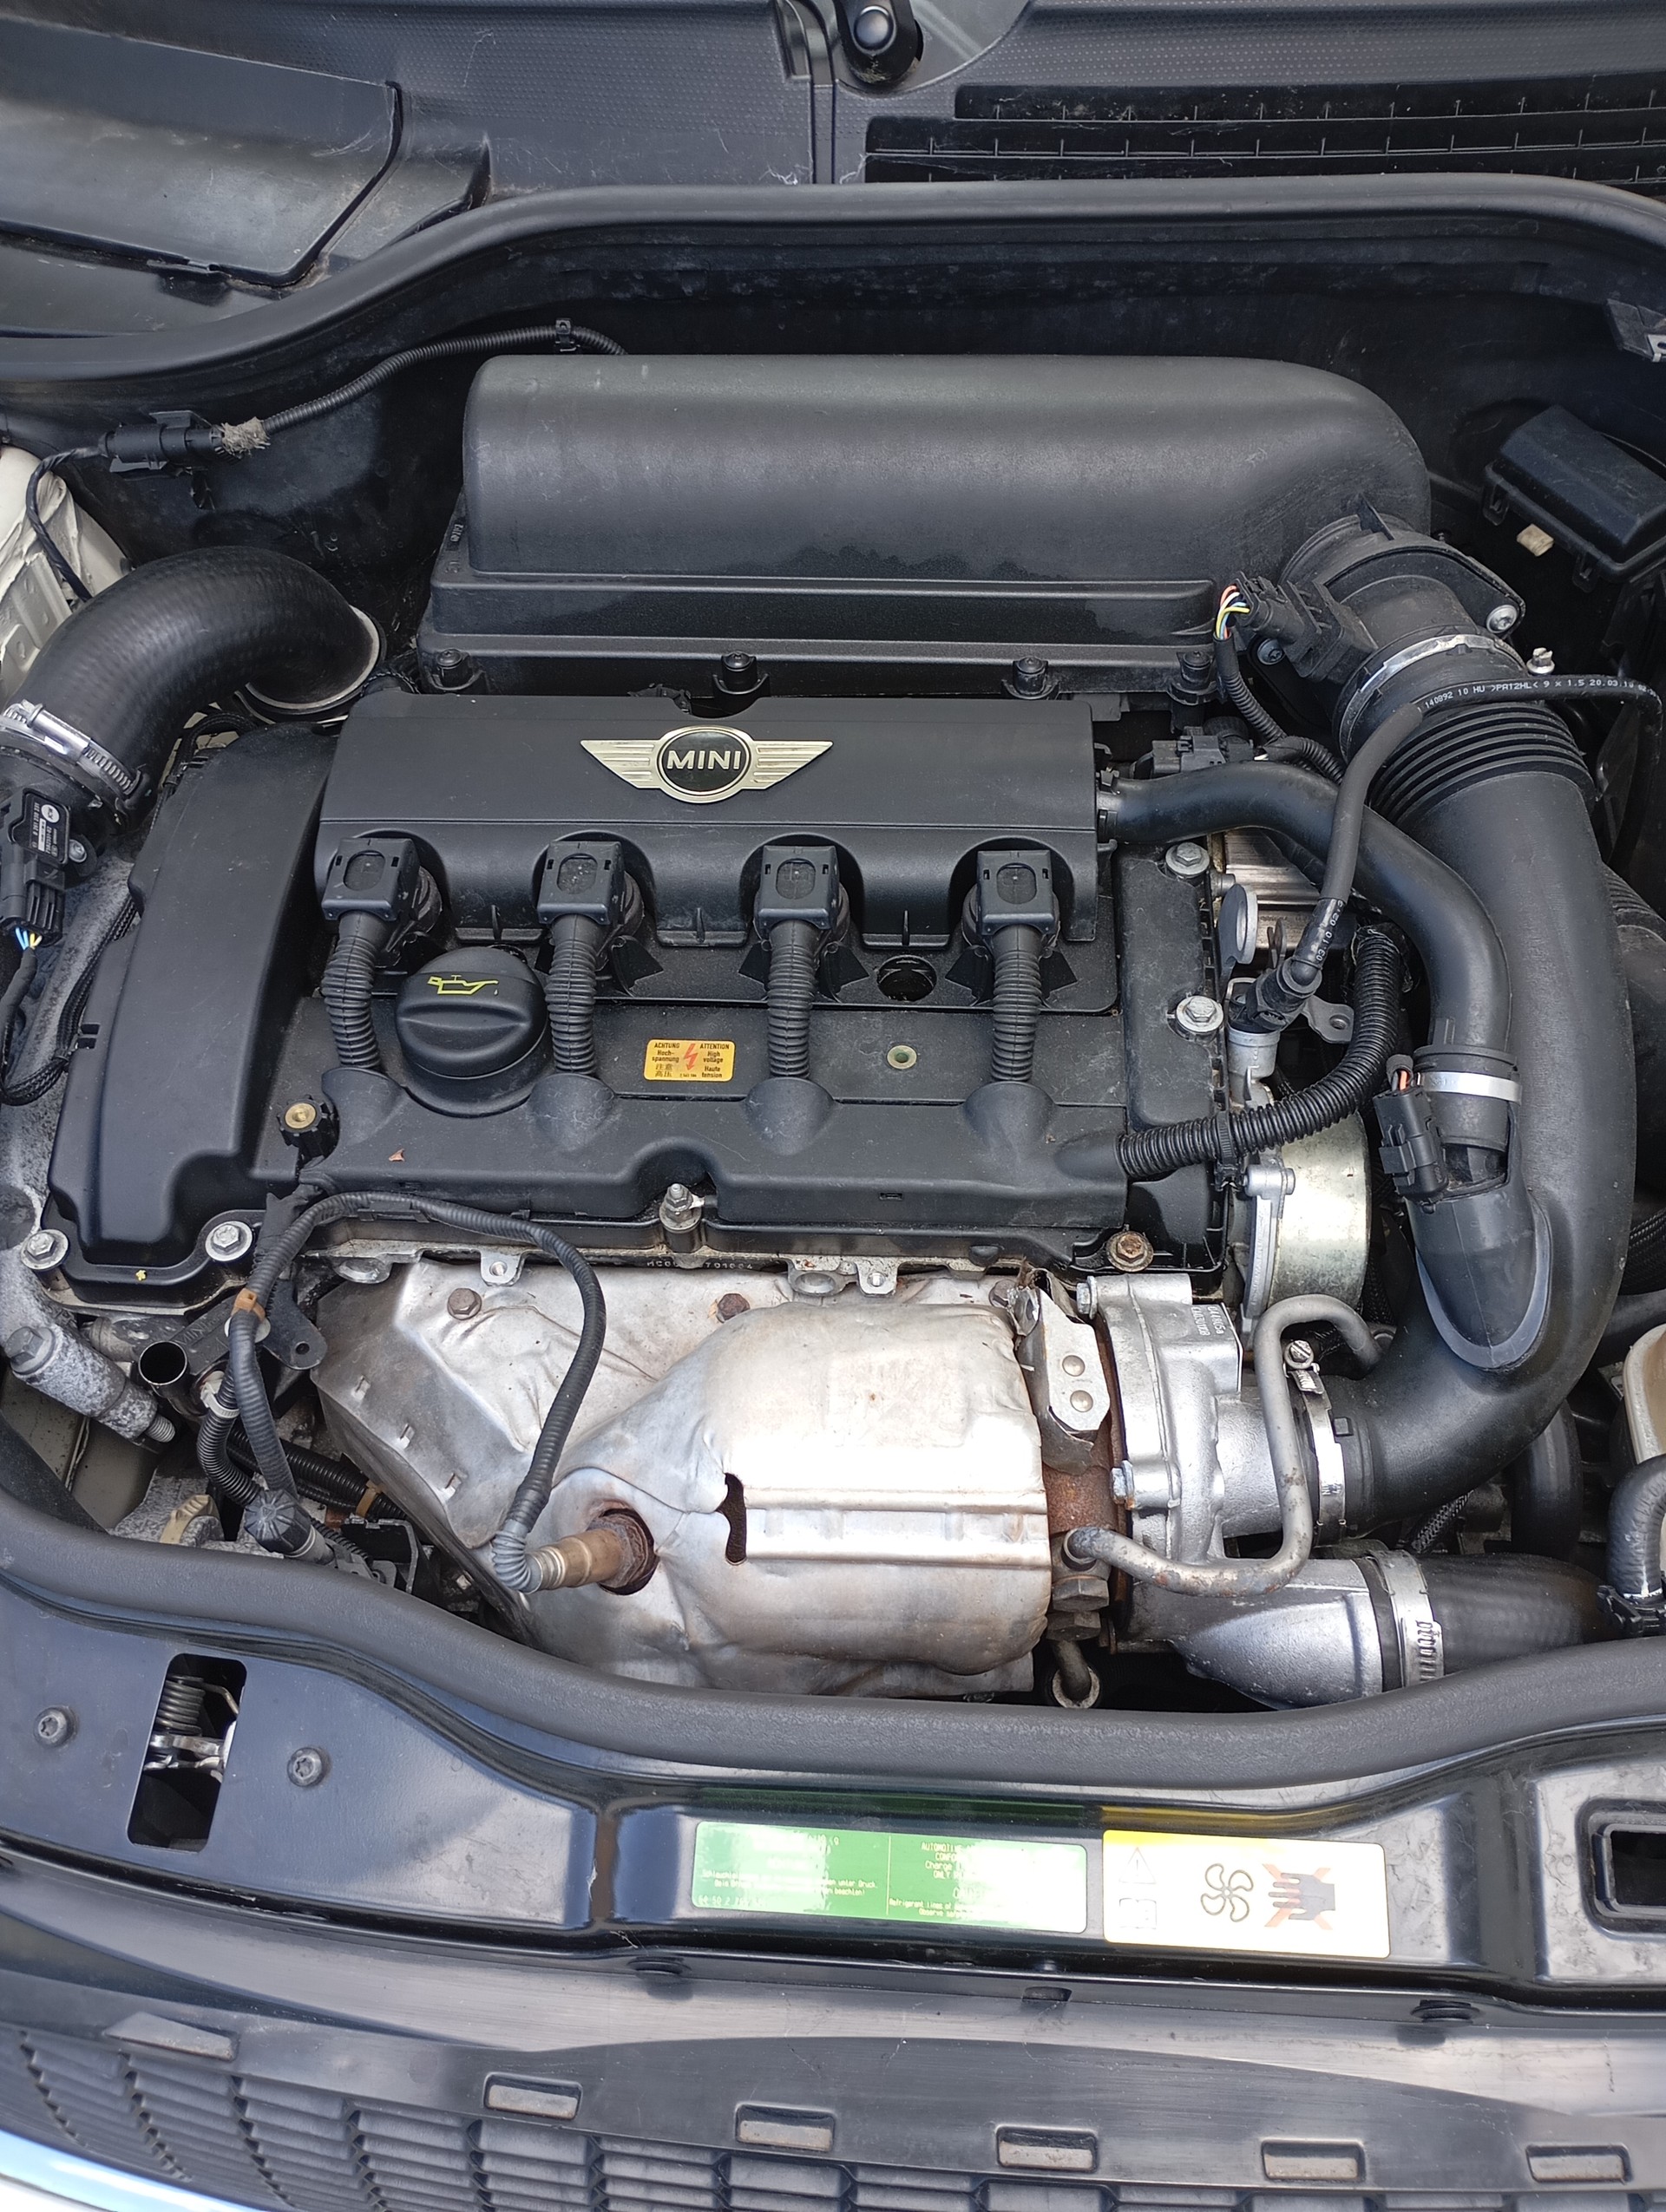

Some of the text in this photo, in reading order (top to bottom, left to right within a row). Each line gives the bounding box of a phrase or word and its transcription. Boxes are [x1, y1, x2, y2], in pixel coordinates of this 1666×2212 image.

[1458, 686, 1470, 697] 10
[1473, 684, 1486, 694] HU
[666, 749, 742, 770] MINI
[924, 1861, 953, 1871] Charge
[933, 1870, 951, 1880] ONLY
